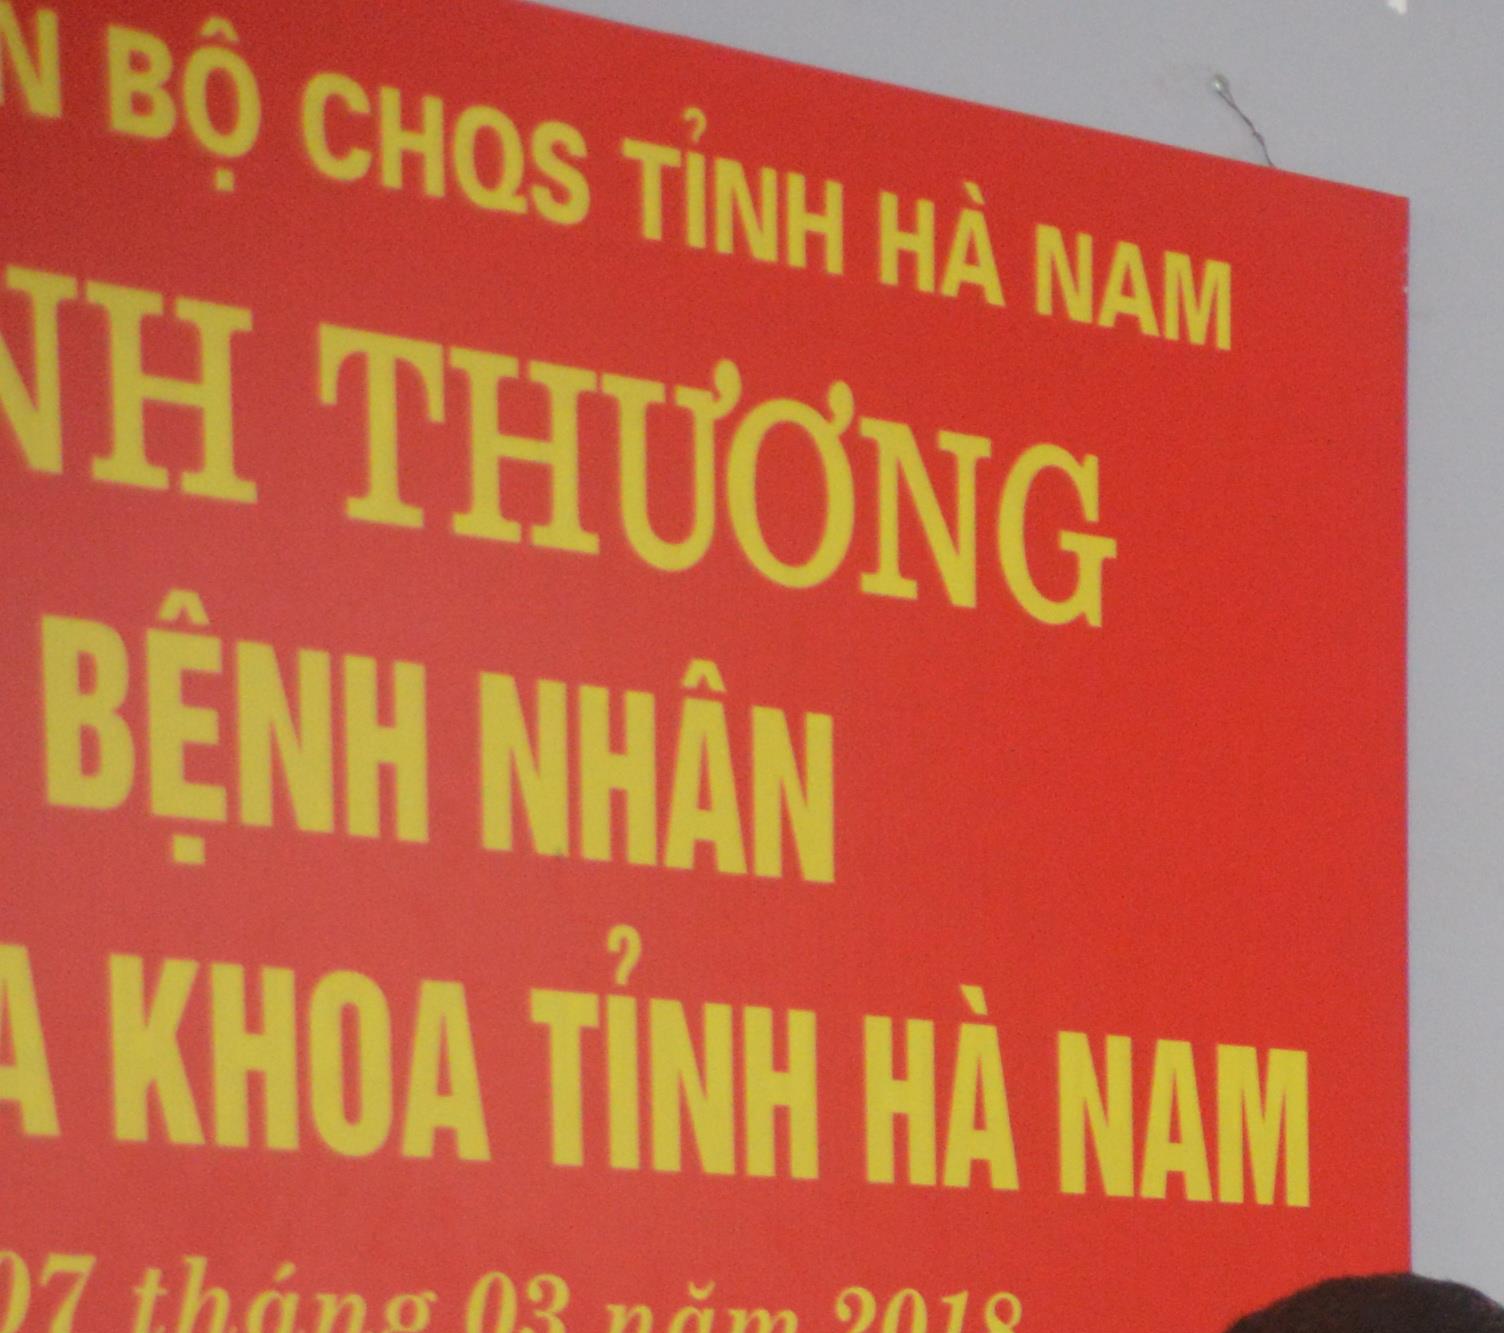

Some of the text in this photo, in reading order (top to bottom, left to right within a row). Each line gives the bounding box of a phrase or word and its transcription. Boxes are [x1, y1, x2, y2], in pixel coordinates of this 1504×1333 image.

[106, 16, 262, 193] BỘ
[300, 71, 591, 226] CHQS
[620, 106, 845, 276] TỈNH
[877, 180, 1006, 307] HÀ
[1034, 222, 1233, 351] NAM
[317, 322, 1119, 629] THƯƠNG
[39, 587, 837, 884] BỆNH NHÂN
[105, 952, 493, 1163] KHOA
[526, 922, 821, 1181] TỈNH
[862, 982, 1021, 1192] HÀ
[1055, 1029, 1311, 1209] NAM
